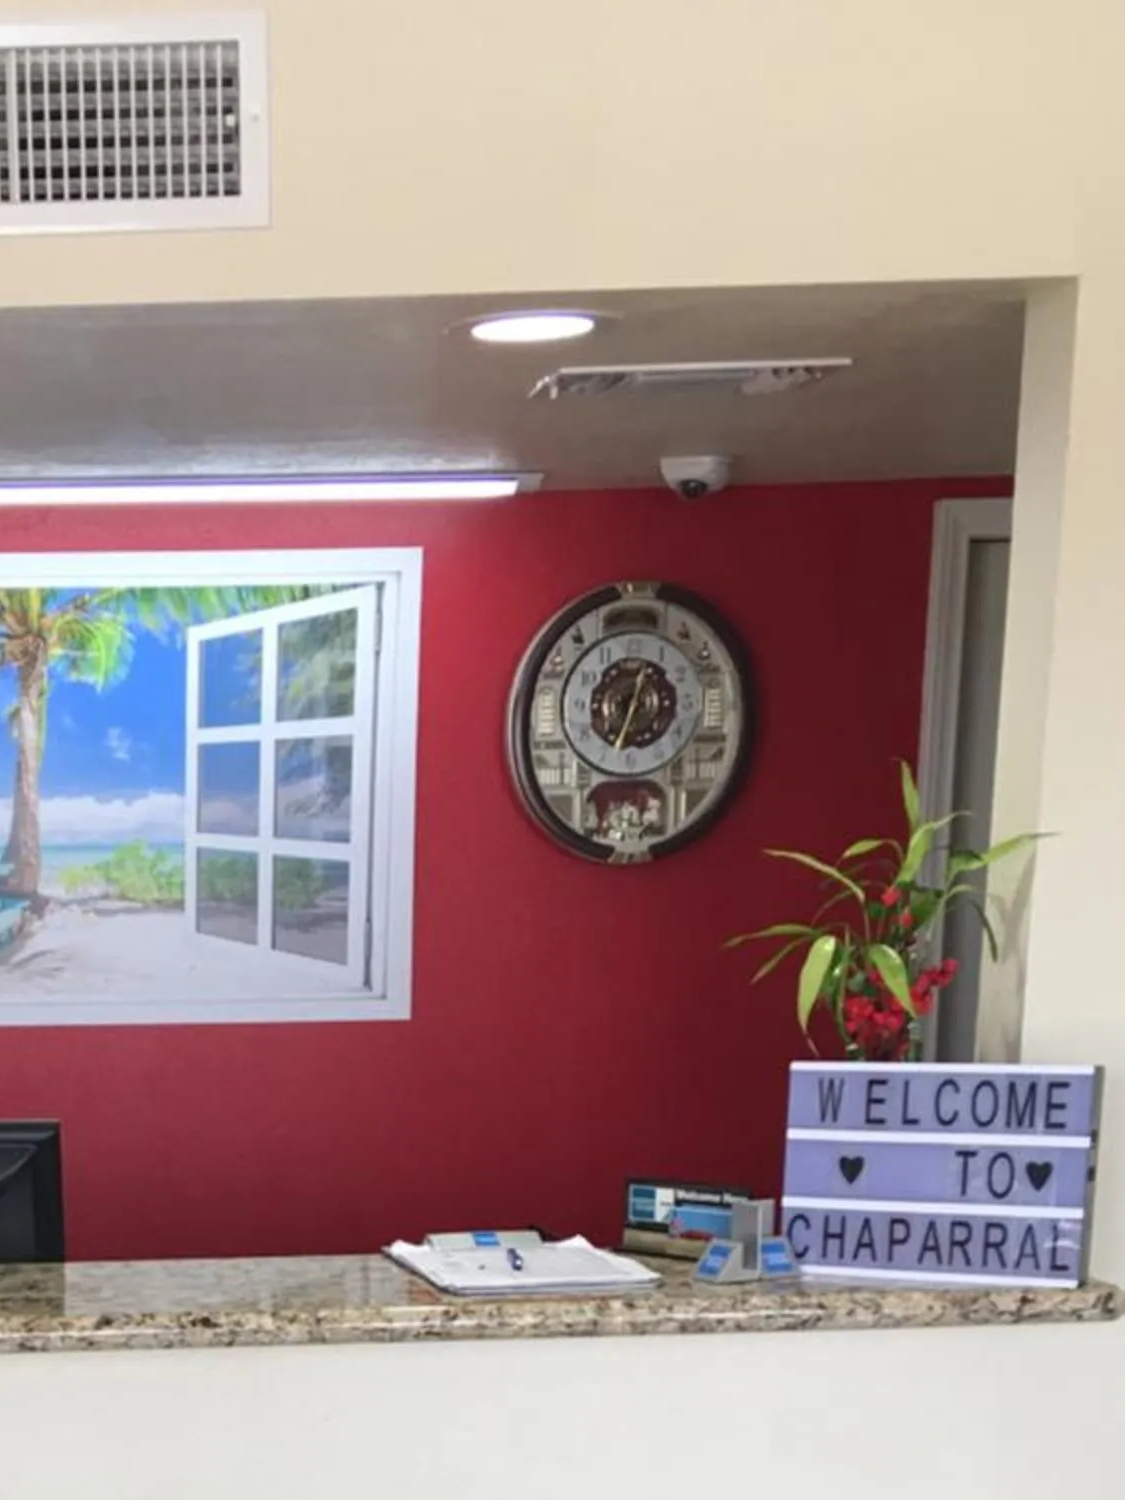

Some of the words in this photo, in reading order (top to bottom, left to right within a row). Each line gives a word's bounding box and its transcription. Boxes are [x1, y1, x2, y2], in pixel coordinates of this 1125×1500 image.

[817, 1077, 1071, 1130] WELCOME
[955, 1150, 1015, 1200] TO
[787, 1213, 1070, 1272] CHAPARRAL
